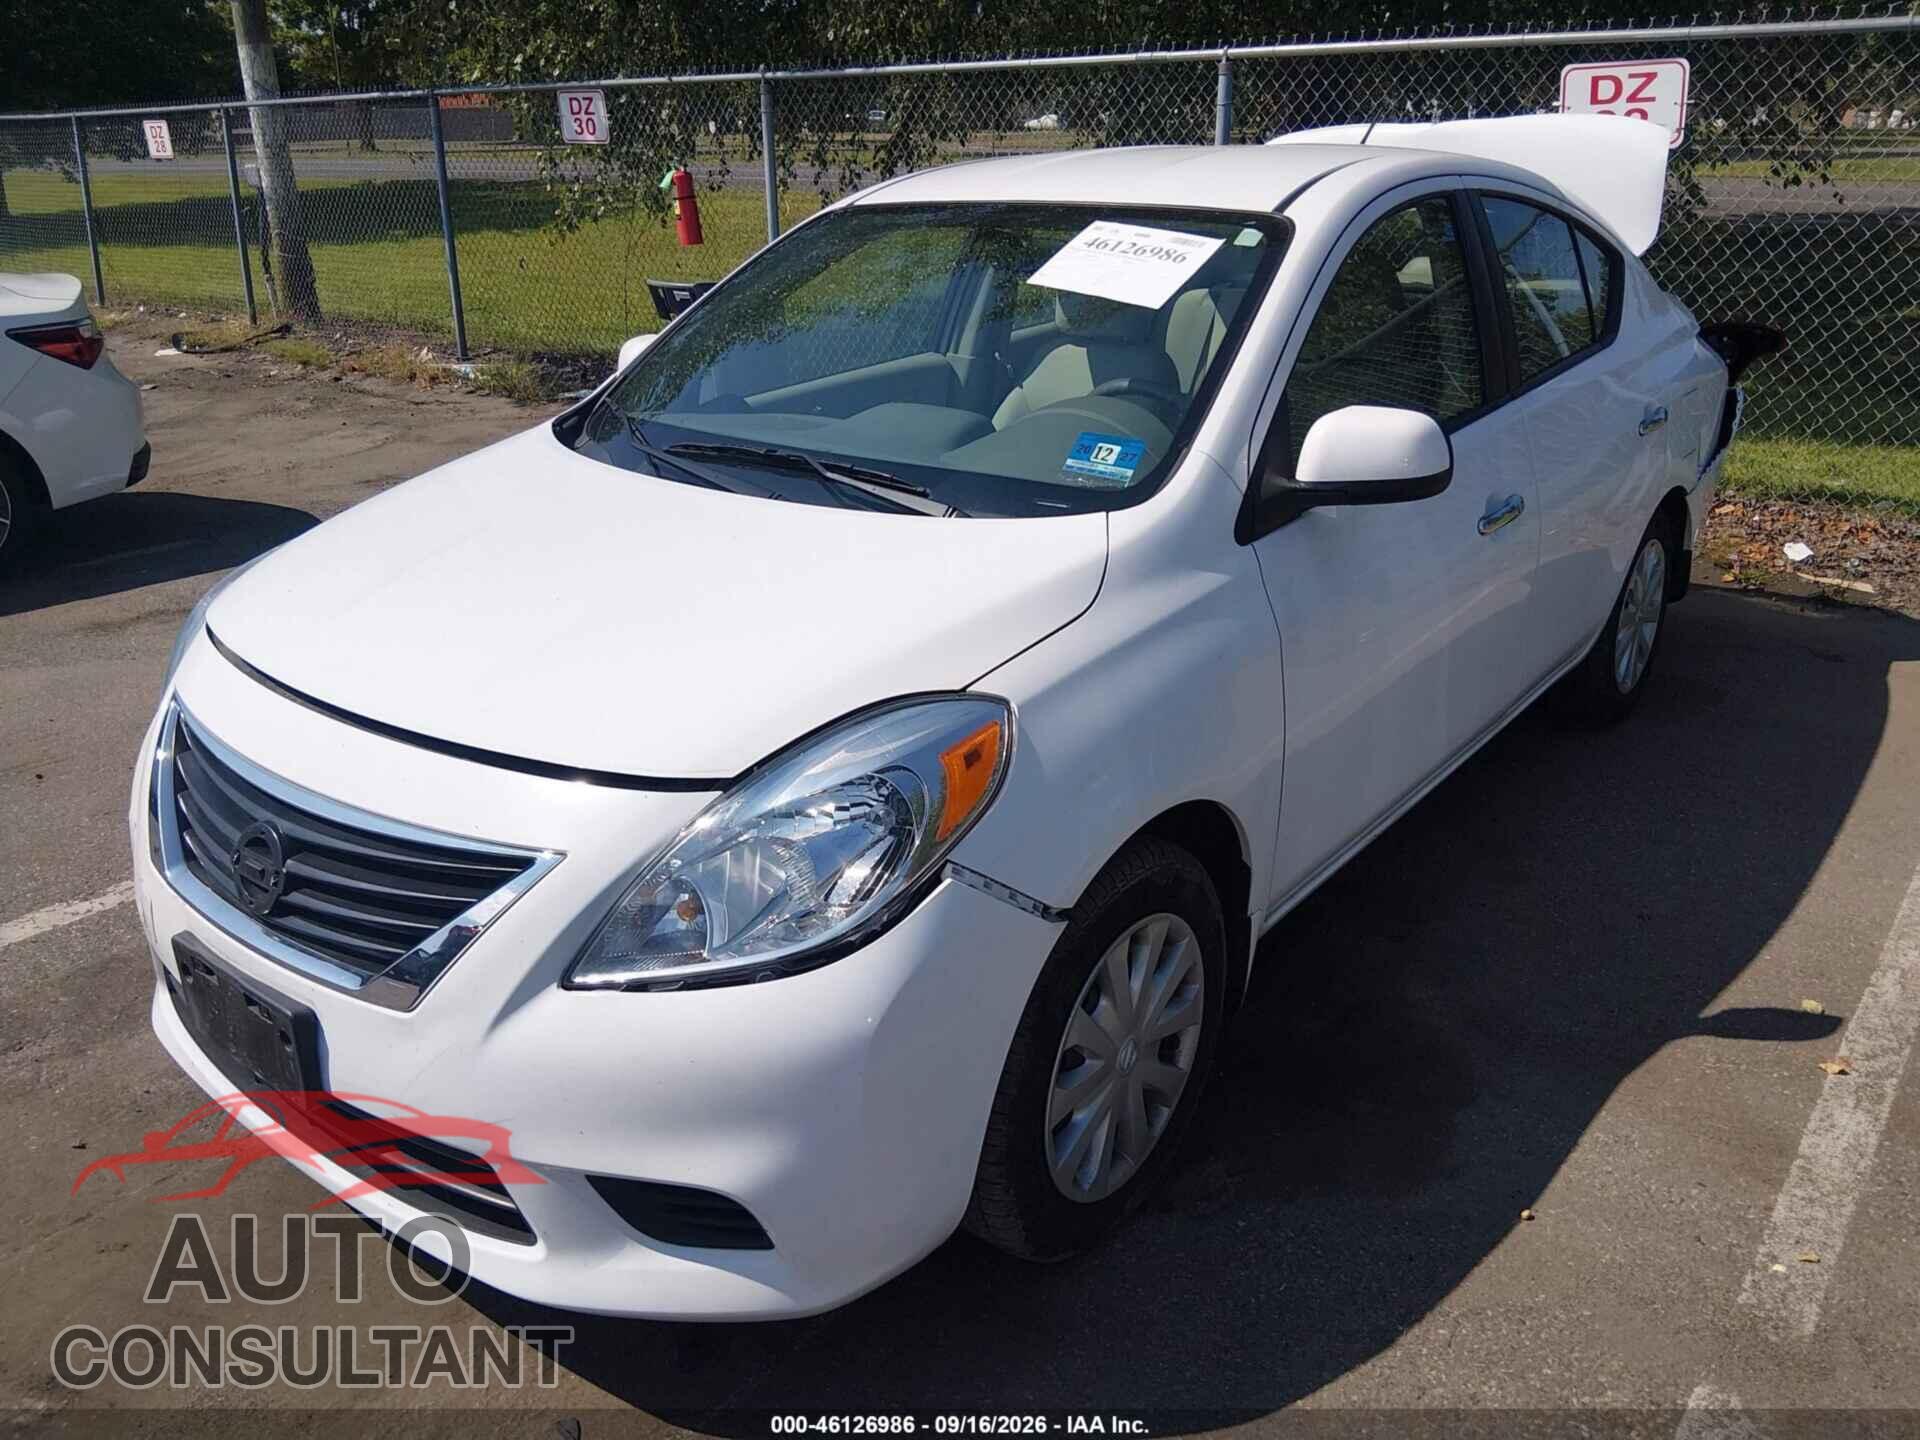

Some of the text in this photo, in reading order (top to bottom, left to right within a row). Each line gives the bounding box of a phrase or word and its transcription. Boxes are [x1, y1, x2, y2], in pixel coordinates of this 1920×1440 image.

[1589, 71, 1659, 106] DZ
[568, 96, 596, 116] DZ
[149, 125, 166, 139] DZ
[573, 117, 597, 137] 30
[153, 139, 168, 153] 28
[1083, 236, 1192, 265] 46126986
[1092, 446, 1114, 462] 12
